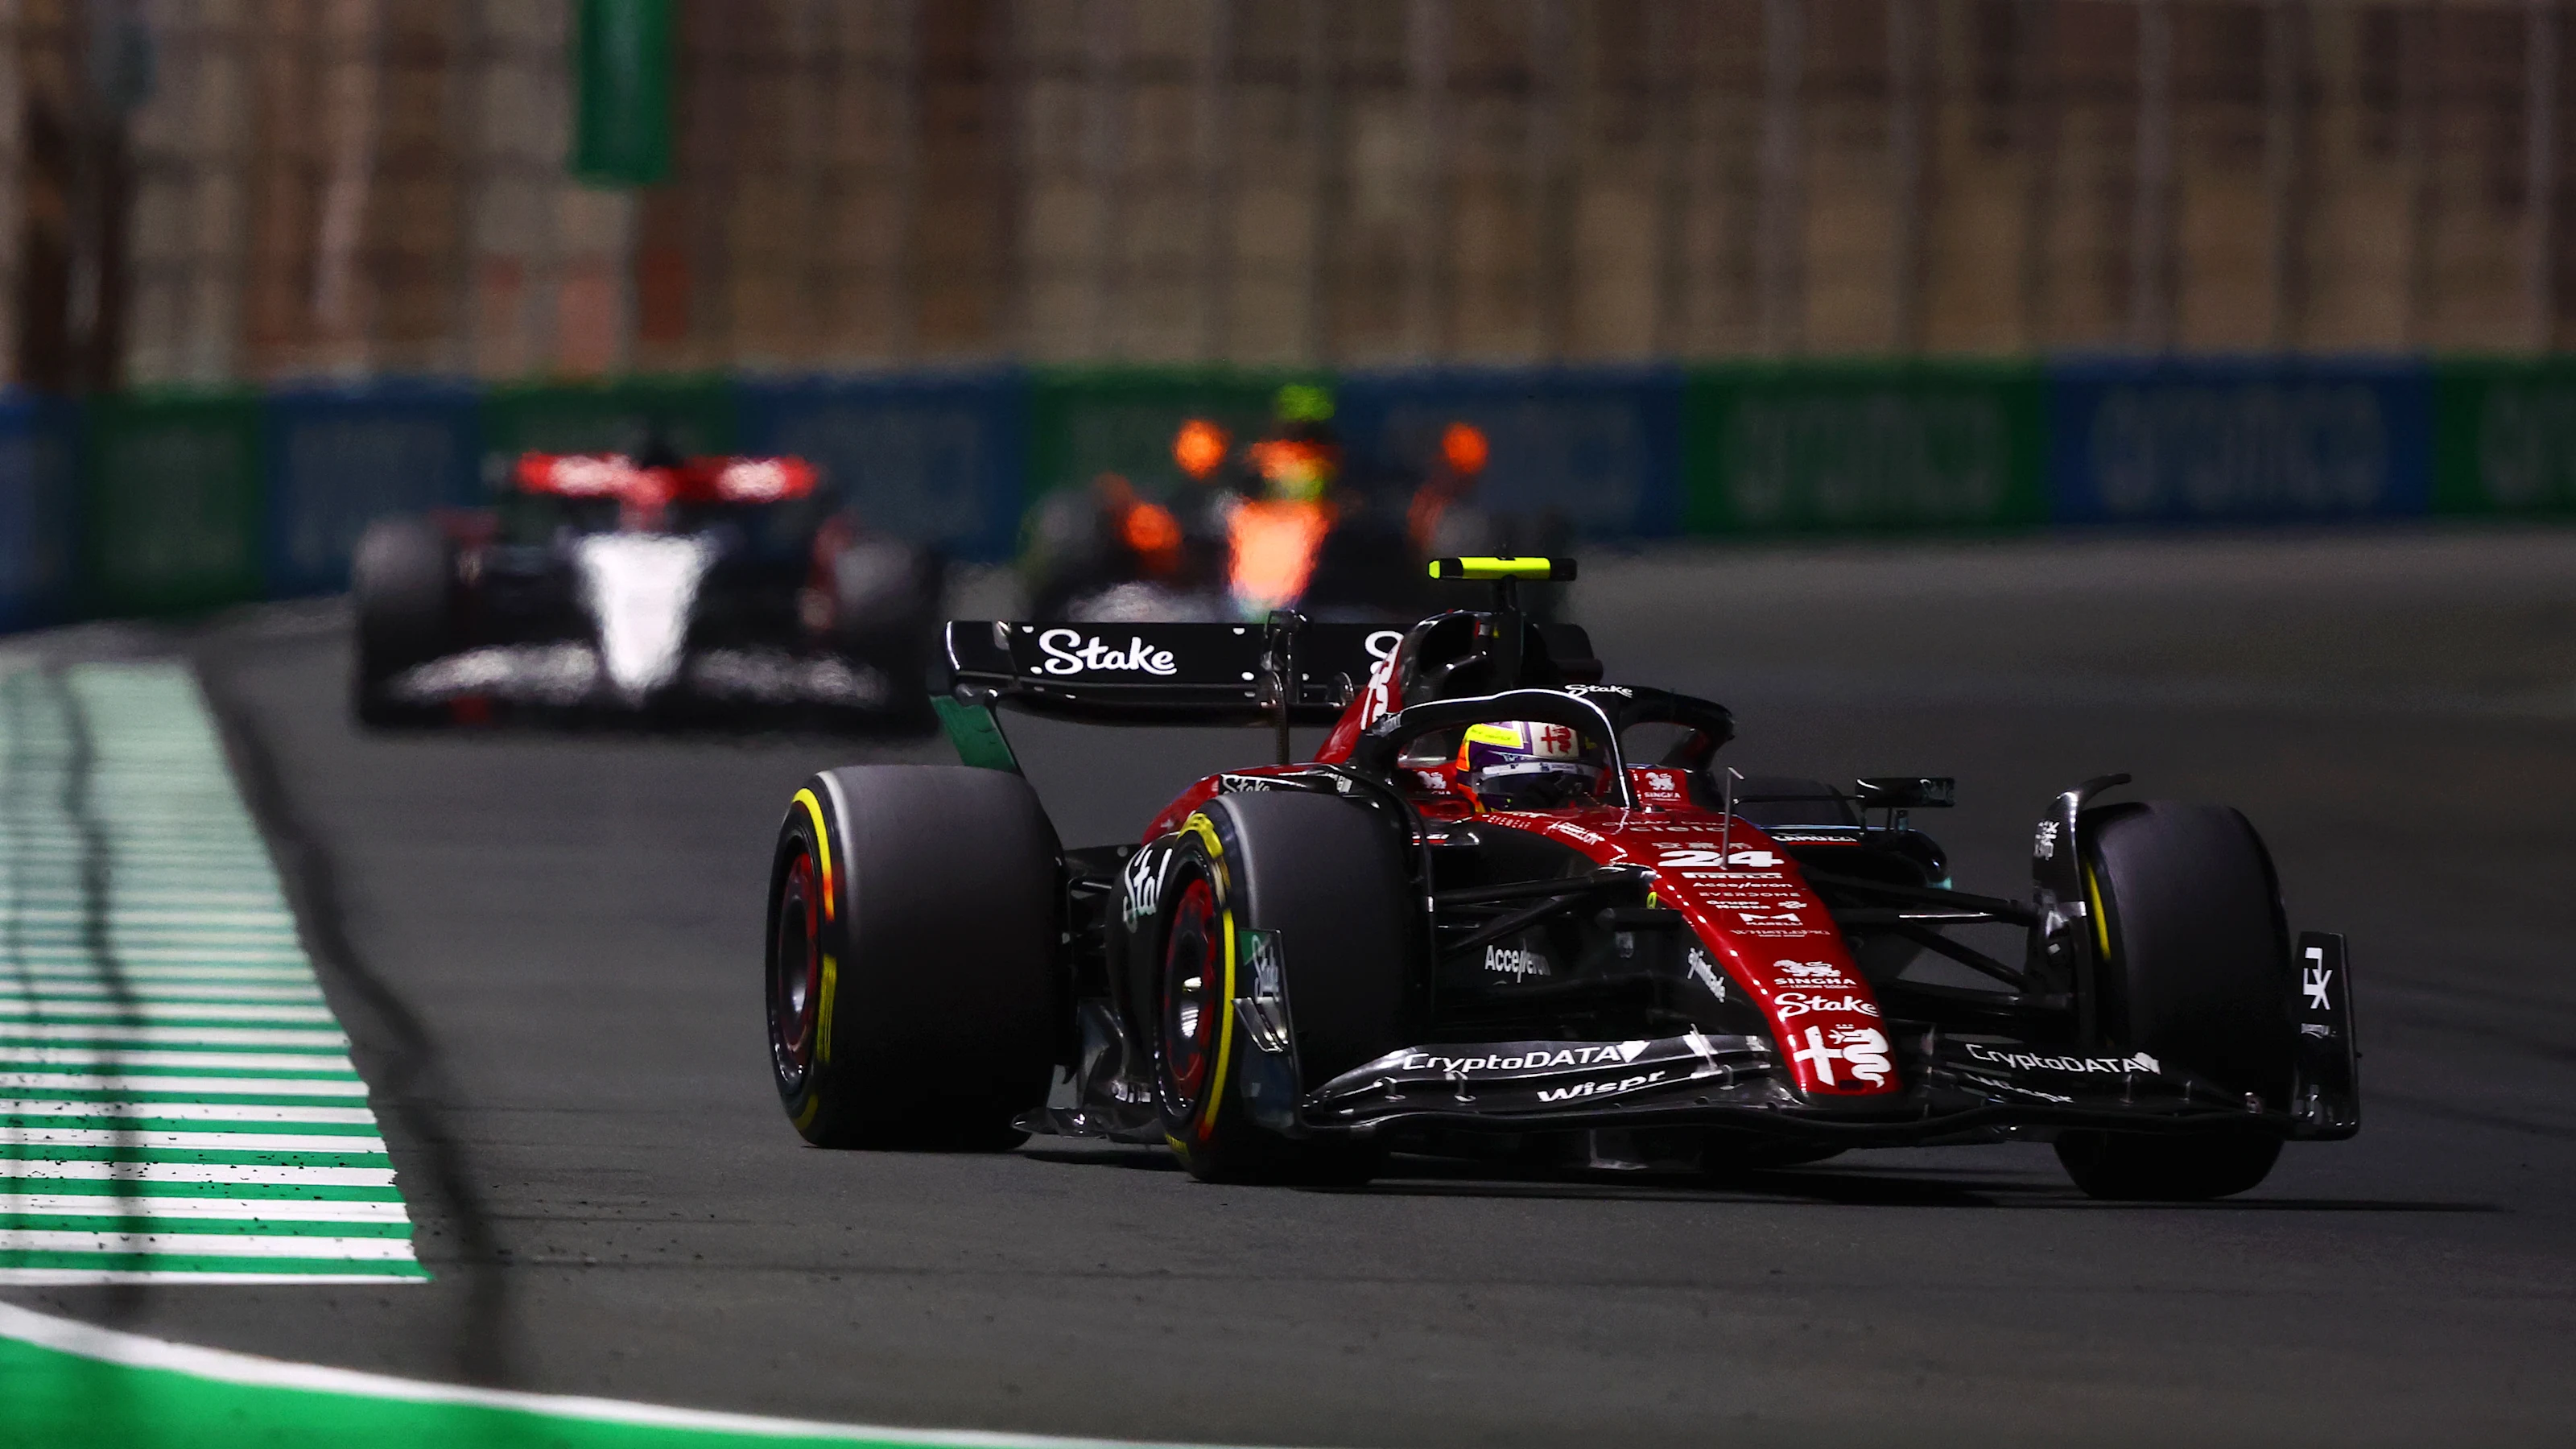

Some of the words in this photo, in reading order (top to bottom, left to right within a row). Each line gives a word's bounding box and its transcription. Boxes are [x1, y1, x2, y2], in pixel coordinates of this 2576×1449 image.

[1039, 629, 1178, 675] Stake
[1564, 684, 1633, 699] Stake
[1657, 850, 1784, 868] 24
[1773, 993, 1880, 1019] Stake
[1402, 1046, 1621, 1072] CryptoDATA
[1965, 1043, 2149, 1073] CryptoDATA
[1537, 1071, 1666, 1102] Wispr
